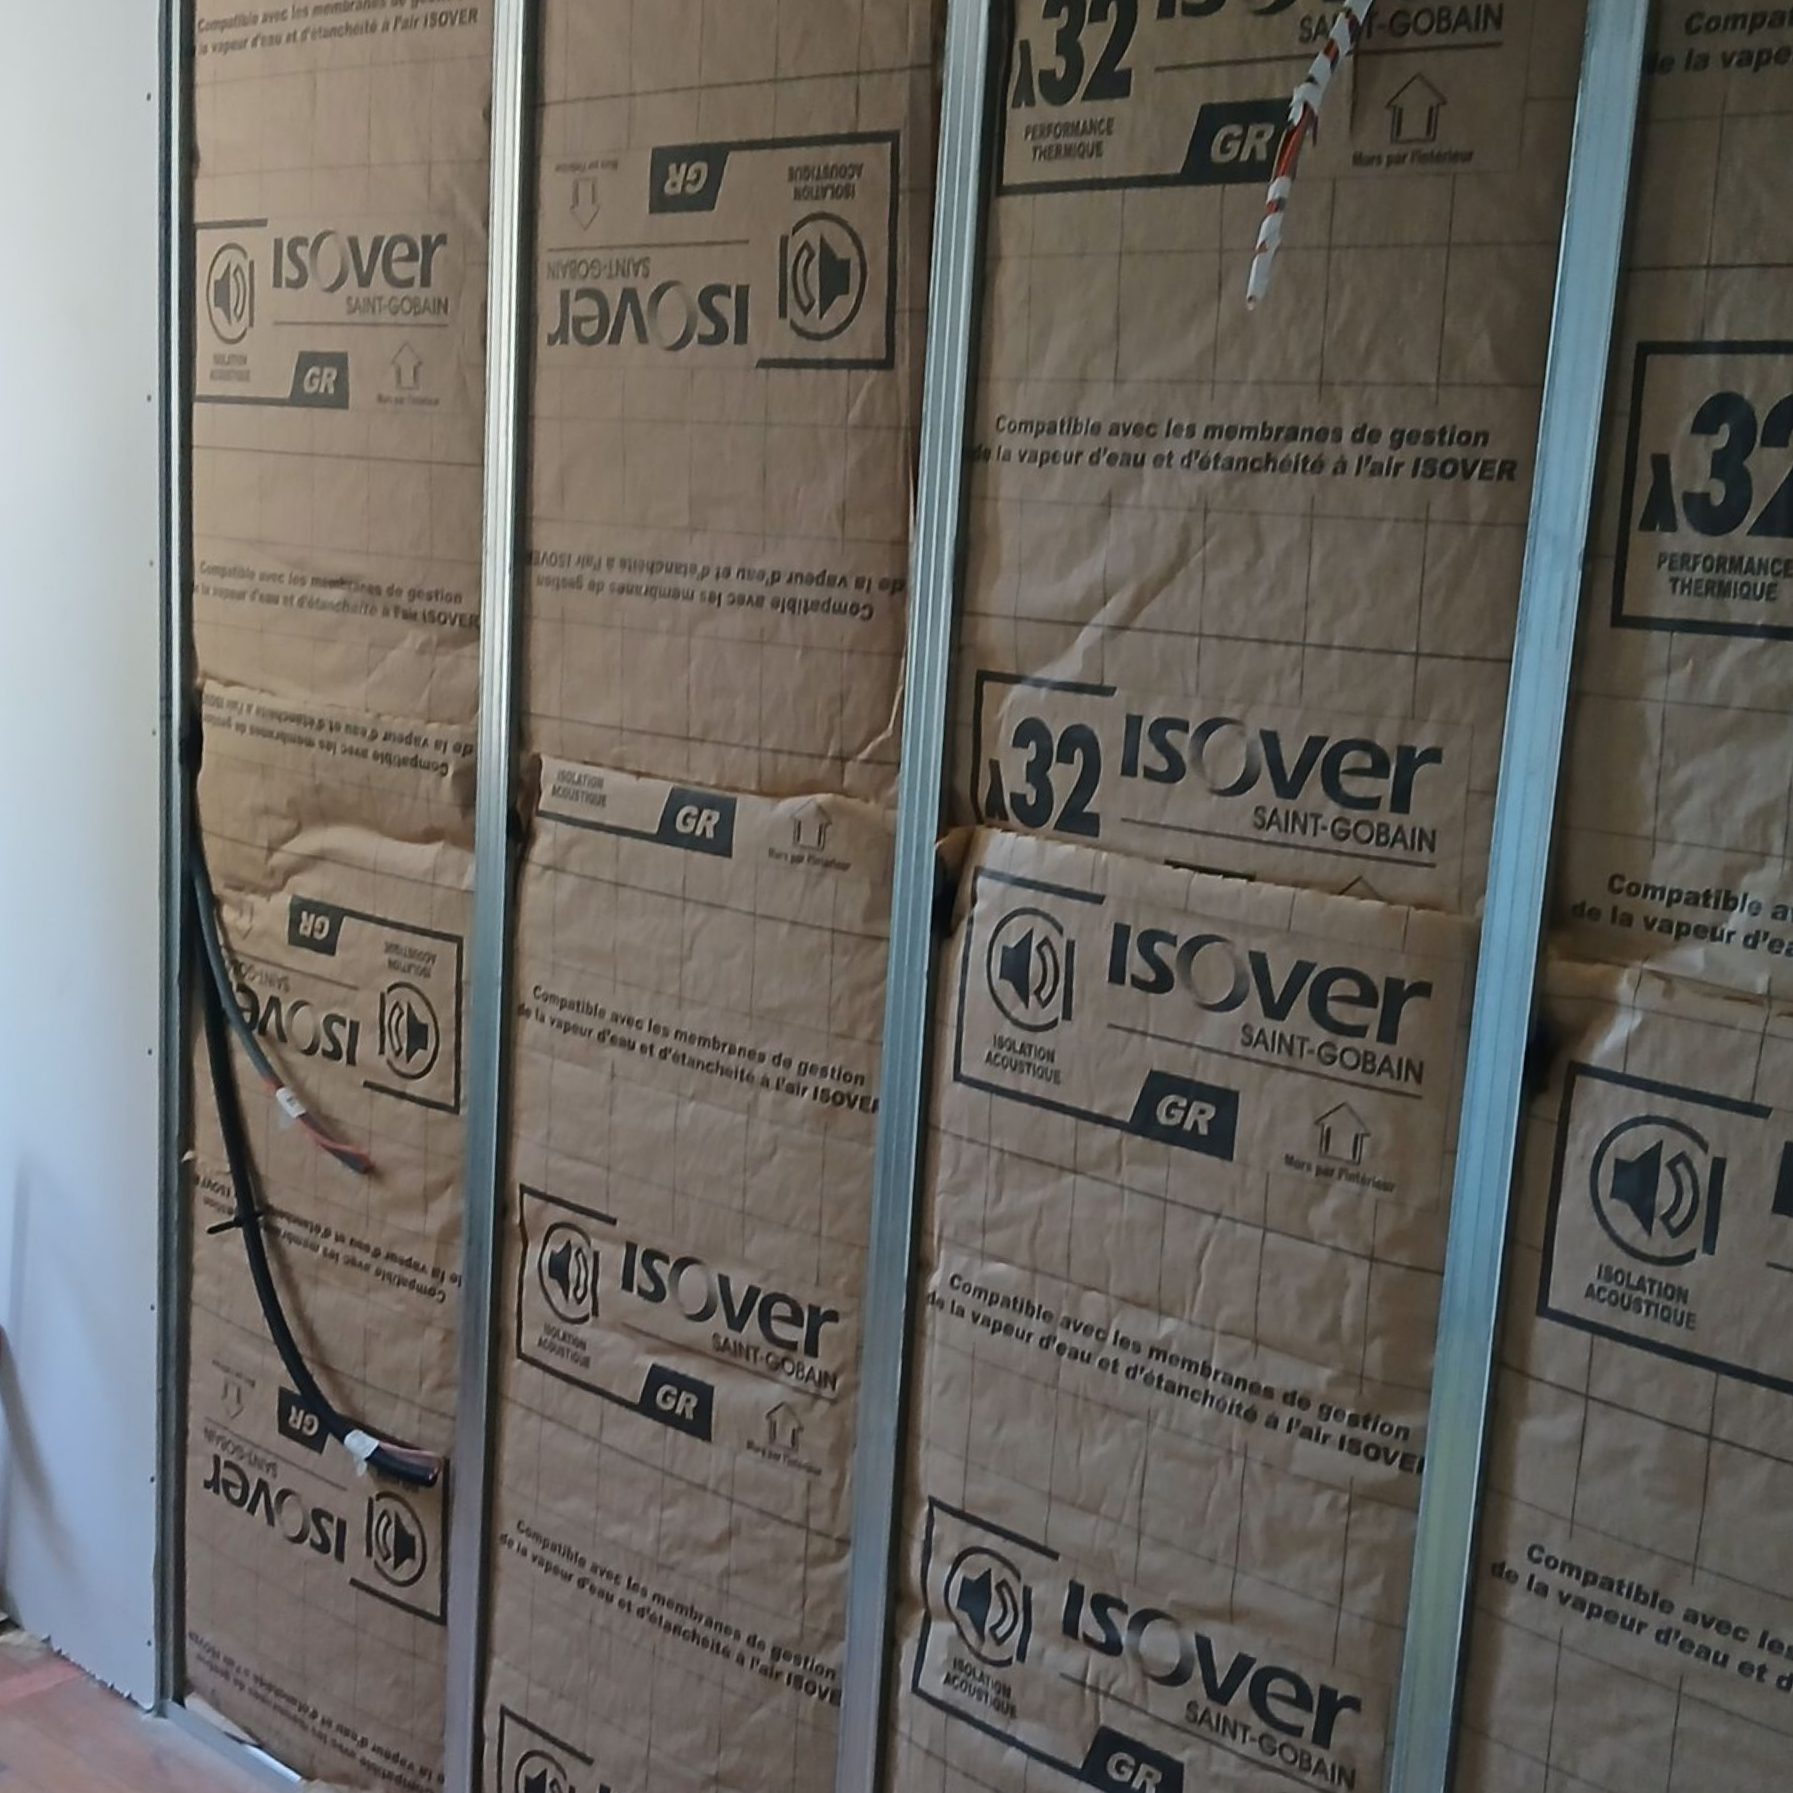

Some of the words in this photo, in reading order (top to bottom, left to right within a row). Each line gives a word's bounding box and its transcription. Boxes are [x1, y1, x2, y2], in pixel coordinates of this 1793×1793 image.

[423, 7, 479, 29] ISOVER
[1684, 48, 1710, 72] la
[1024, 117, 1116, 140] PERFORMANCE
[1210, 123, 1273, 163] GR
[1031, 139, 1104, 161] THERMIQUE
[664, 161, 708, 196] GR
[793, 182, 856, 200] ISOLATION
[546, 257, 651, 279] SAINT-GOBAIN
[346, 296, 449, 317] SAINT-GOBAIN
[303, 366, 338, 394] GR
[995, 414, 1101, 439] Compatible
[1106, 421, 1158, 439] avec
[1164, 418, 1197, 439] les
[1202, 420, 1344, 443] membranes
[1350, 423, 1383, 444] de
[1388, 424, 1491, 451] gestion
[996, 444, 1012, 463] la
[1018, 447, 1083, 469] vapeur
[1087, 447, 1146, 468] d'eau
[1151, 450, 1174, 470] et
[1354, 455, 1404, 478] l'air
[1411, 457, 1518, 481] ISOVER
[586, 580, 605, 597] de
[715, 565, 732, 583] et
[735, 566, 781, 588] d'eau
[786, 569, 848, 590] vapeur
[855, 575, 873, 594] la
[1668, 576, 1778, 602] THERMIQUE
[407, 587, 464, 606] gestion
[608, 581, 696, 604] membranes
[698, 590, 722, 609] les
[726, 590, 766, 609] avec
[769, 594, 875, 622] Compatible
[675, 805, 720, 839] GR
[1253, 806, 1438, 855] SAINT-GOBAIN
[1607, 872, 1763, 917] Compatible
[299, 911, 330, 939] GR
[1571, 901, 1602, 921] de
[1610, 905, 1634, 928] la
[1643, 914, 1737, 944] vapeur
[532, 984, 608, 1020] Compatible
[611, 1011, 644, 1032] avec
[647, 1017, 670, 1039] les
[673, 1028, 767, 1064] membranes
[771, 1051, 793, 1070] de
[796, 1058, 867, 1088] gestion
[991, 1033, 1057, 1064] ISOLATION
[549, 1015, 593, 1039] vapeur
[596, 1028, 637, 1053] d'eau
[639, 1040, 656, 1058] et
[775, 1075, 809, 1099] l'air
[985, 1053, 1063, 1086] ACOUSTIQUE
[1241, 1023, 1424, 1086] SAINT-GOBAIN
[1156, 1094, 1217, 1136] GR
[1596, 1263, 1690, 1305] ISOLATION
[1584, 1282, 1697, 1331] ACOUSTIQUE
[711, 1331, 840, 1392] SAINT-GOBAIN
[948, 1272, 1055, 1325] Compatible
[1059, 1313, 1109, 1343] avec
[1112, 1327, 1143, 1357] les
[1147, 1342, 1277, 1402] membranes
[1281, 1386, 1312, 1413] de
[1316, 1398, 1412, 1442] gestion
[950, 1297, 966, 1320] la
[970, 1308, 1035, 1346] vapeur
[1038, 1327, 1092, 1366] d'eau
[1097, 1352, 1120, 1377] et
[1285, 1415, 1333, 1446] l'air
[656, 1384, 698, 1420] GR
[288, 1405, 319, 1436] GR
[516, 1518, 587, 1569] Compatible
[590, 1560, 623, 1586] avec
[626, 1575, 648, 1599] les
[651, 1591, 741, 1641] membranes
[745, 1632, 767, 1653] de
[770, 1644, 837, 1681] gestion
[1526, 1543, 1676, 1615] Compatible
[1682, 1606, 1751, 1643] avec
[531, 1553, 574, 1583] vapeur
[576, 1575, 615, 1604] d'eau
[748, 1655, 784, 1681] l'air
[1490, 1561, 1519, 1585] de
[1526, 1572, 1550, 1598] la
[1558, 1589, 1649, 1636] vapeur
[1654, 1627, 1730, 1669] d'eau
[1737, 1662, 1768, 1684] et
[1185, 1699, 1357, 1792] SAINT-GOBAIN
[1106, 1751, 1162, 1793] GR
